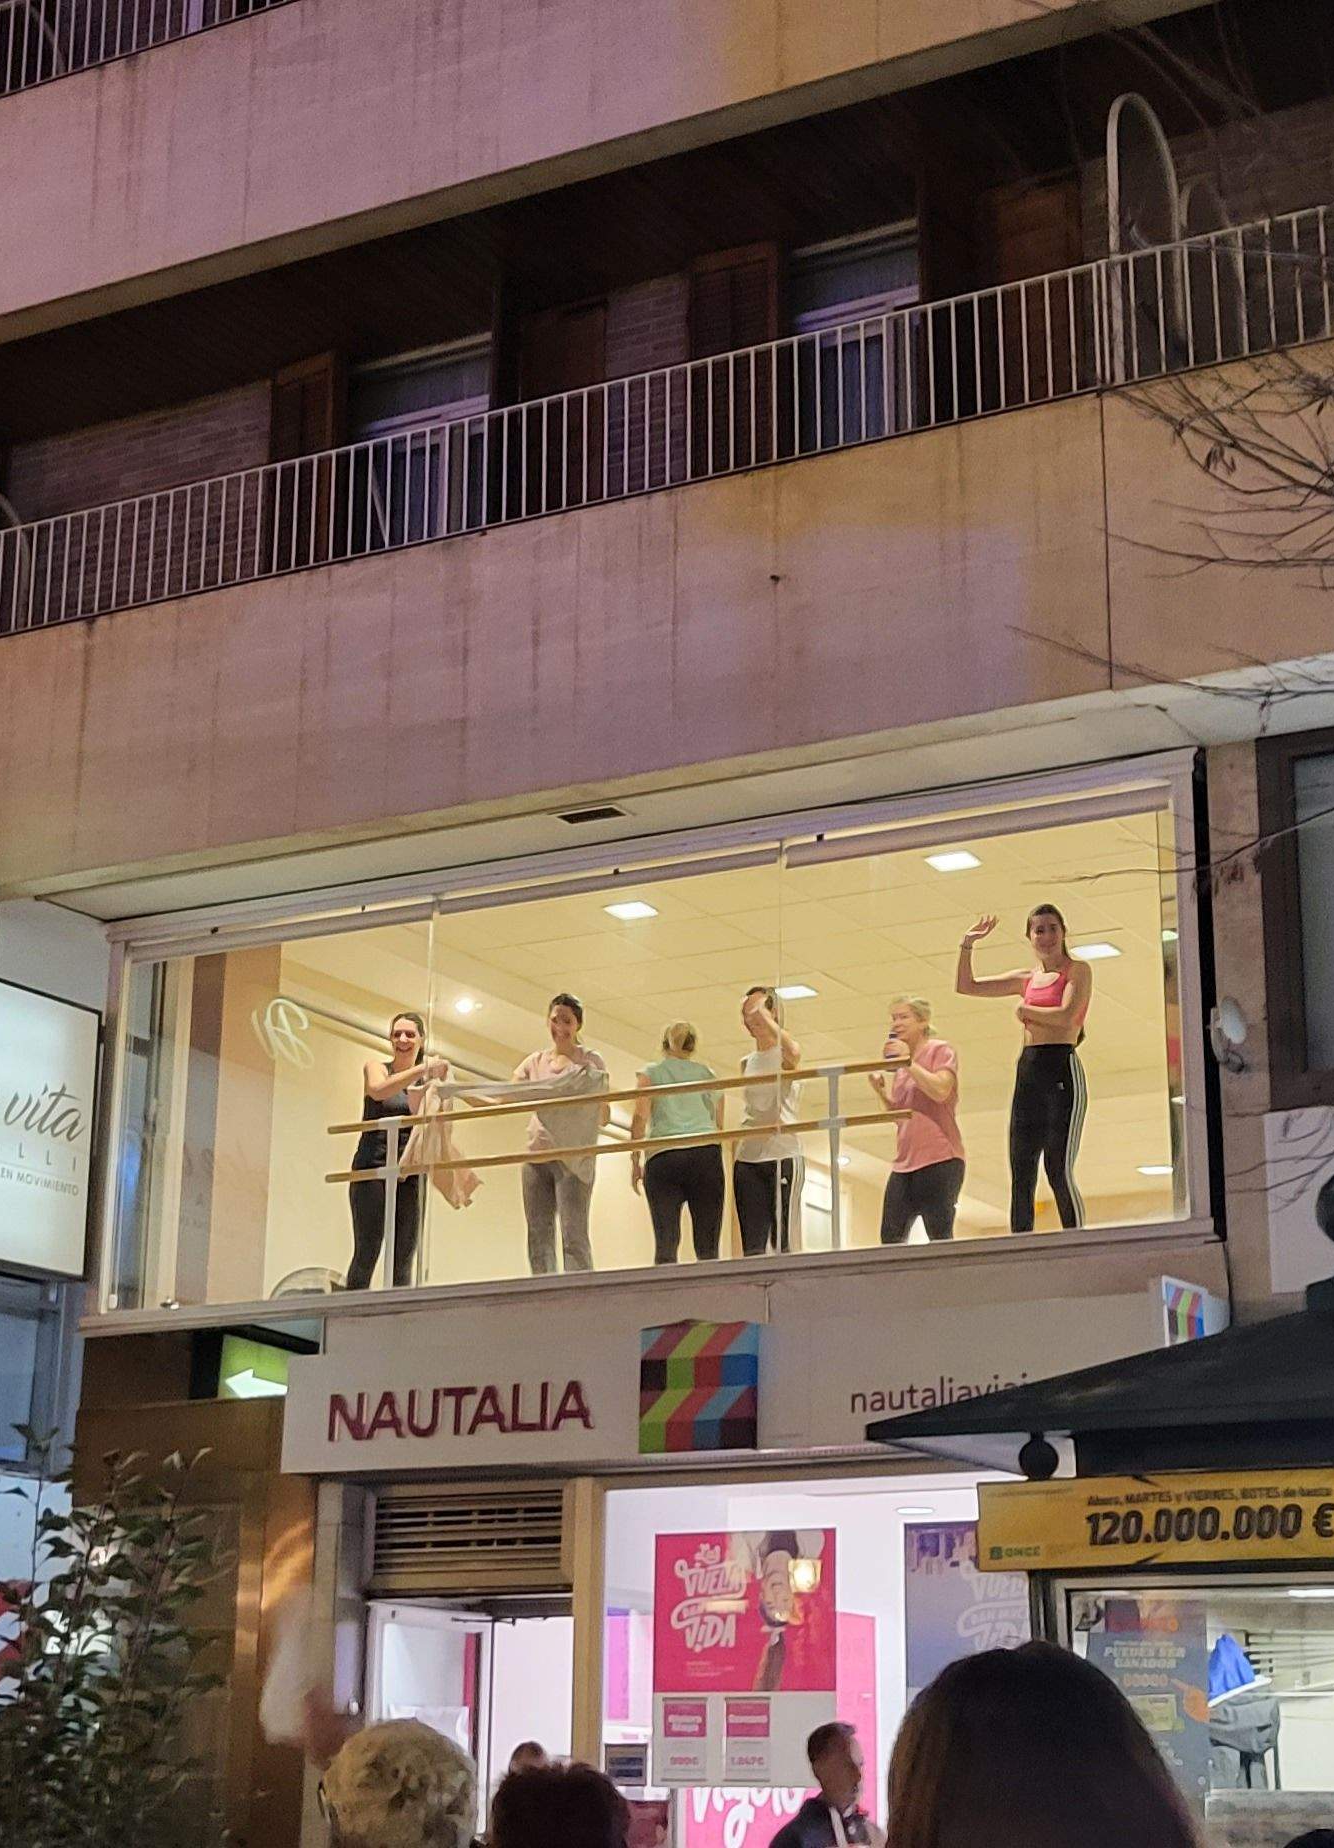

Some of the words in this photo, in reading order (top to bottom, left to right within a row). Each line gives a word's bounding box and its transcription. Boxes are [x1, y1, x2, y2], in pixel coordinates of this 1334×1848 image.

[4, 1082, 85, 1143] vita
[1, 1166, 13, 1181] EN
[16, 1170, 79, 1197] MOVIMIENTO
[328, 1380, 595, 1442] NAUTALIA
[1125, 1491, 1172, 1504] MARTES
[1085, 1503, 1302, 1546] 120.000.000
